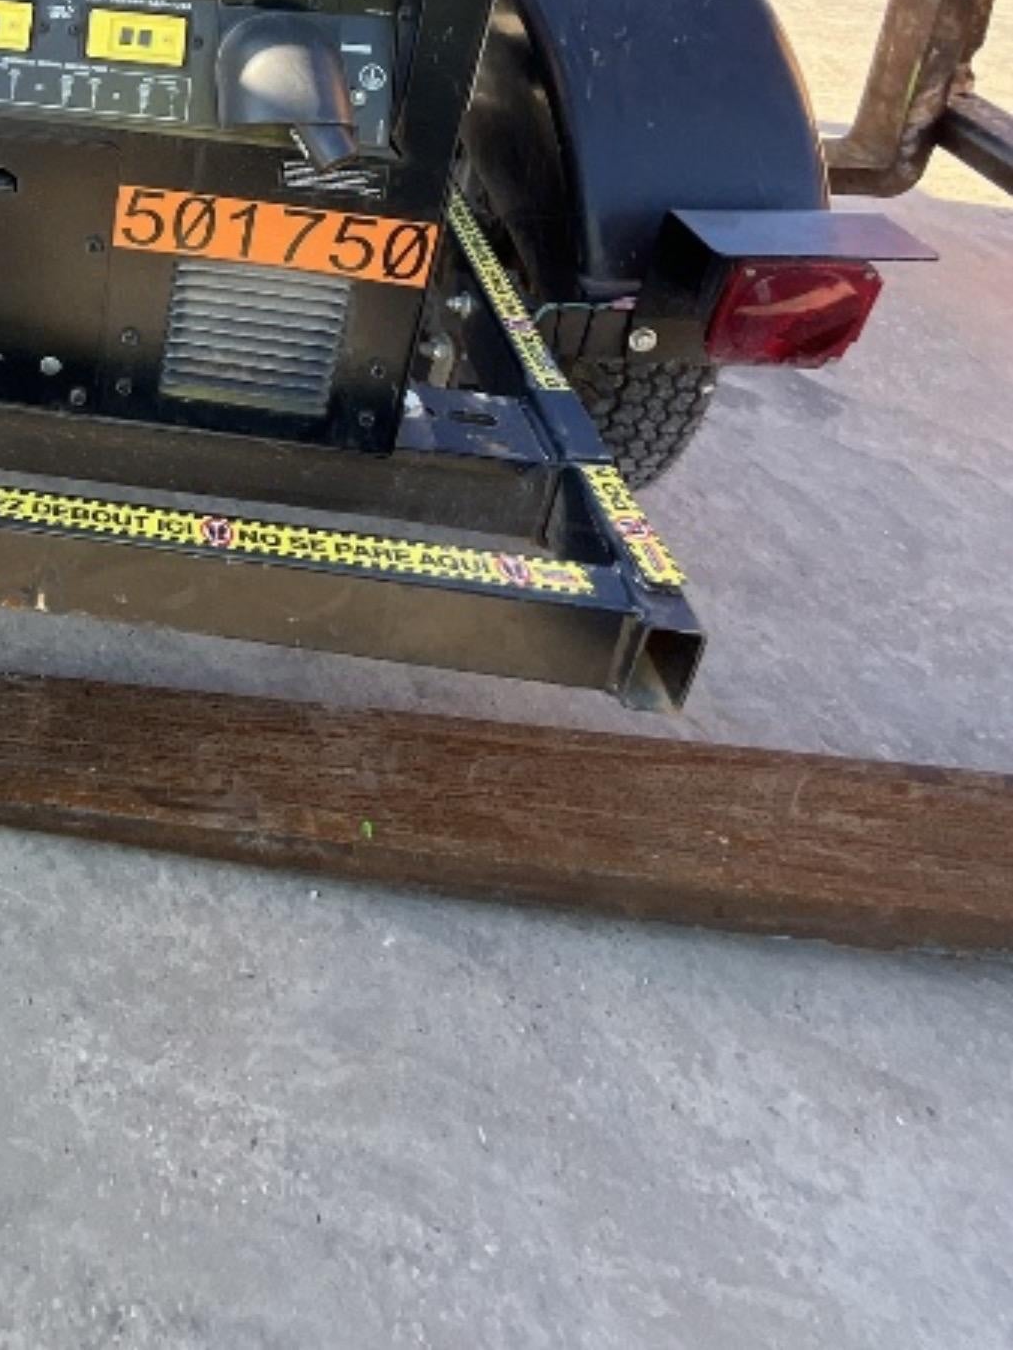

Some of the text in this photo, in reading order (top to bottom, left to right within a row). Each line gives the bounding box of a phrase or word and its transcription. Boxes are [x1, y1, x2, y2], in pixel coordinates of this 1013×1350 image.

[120, 187, 430, 281] 501750
[238, 528, 281, 547] NO
[289, 536, 327, 553] SE
